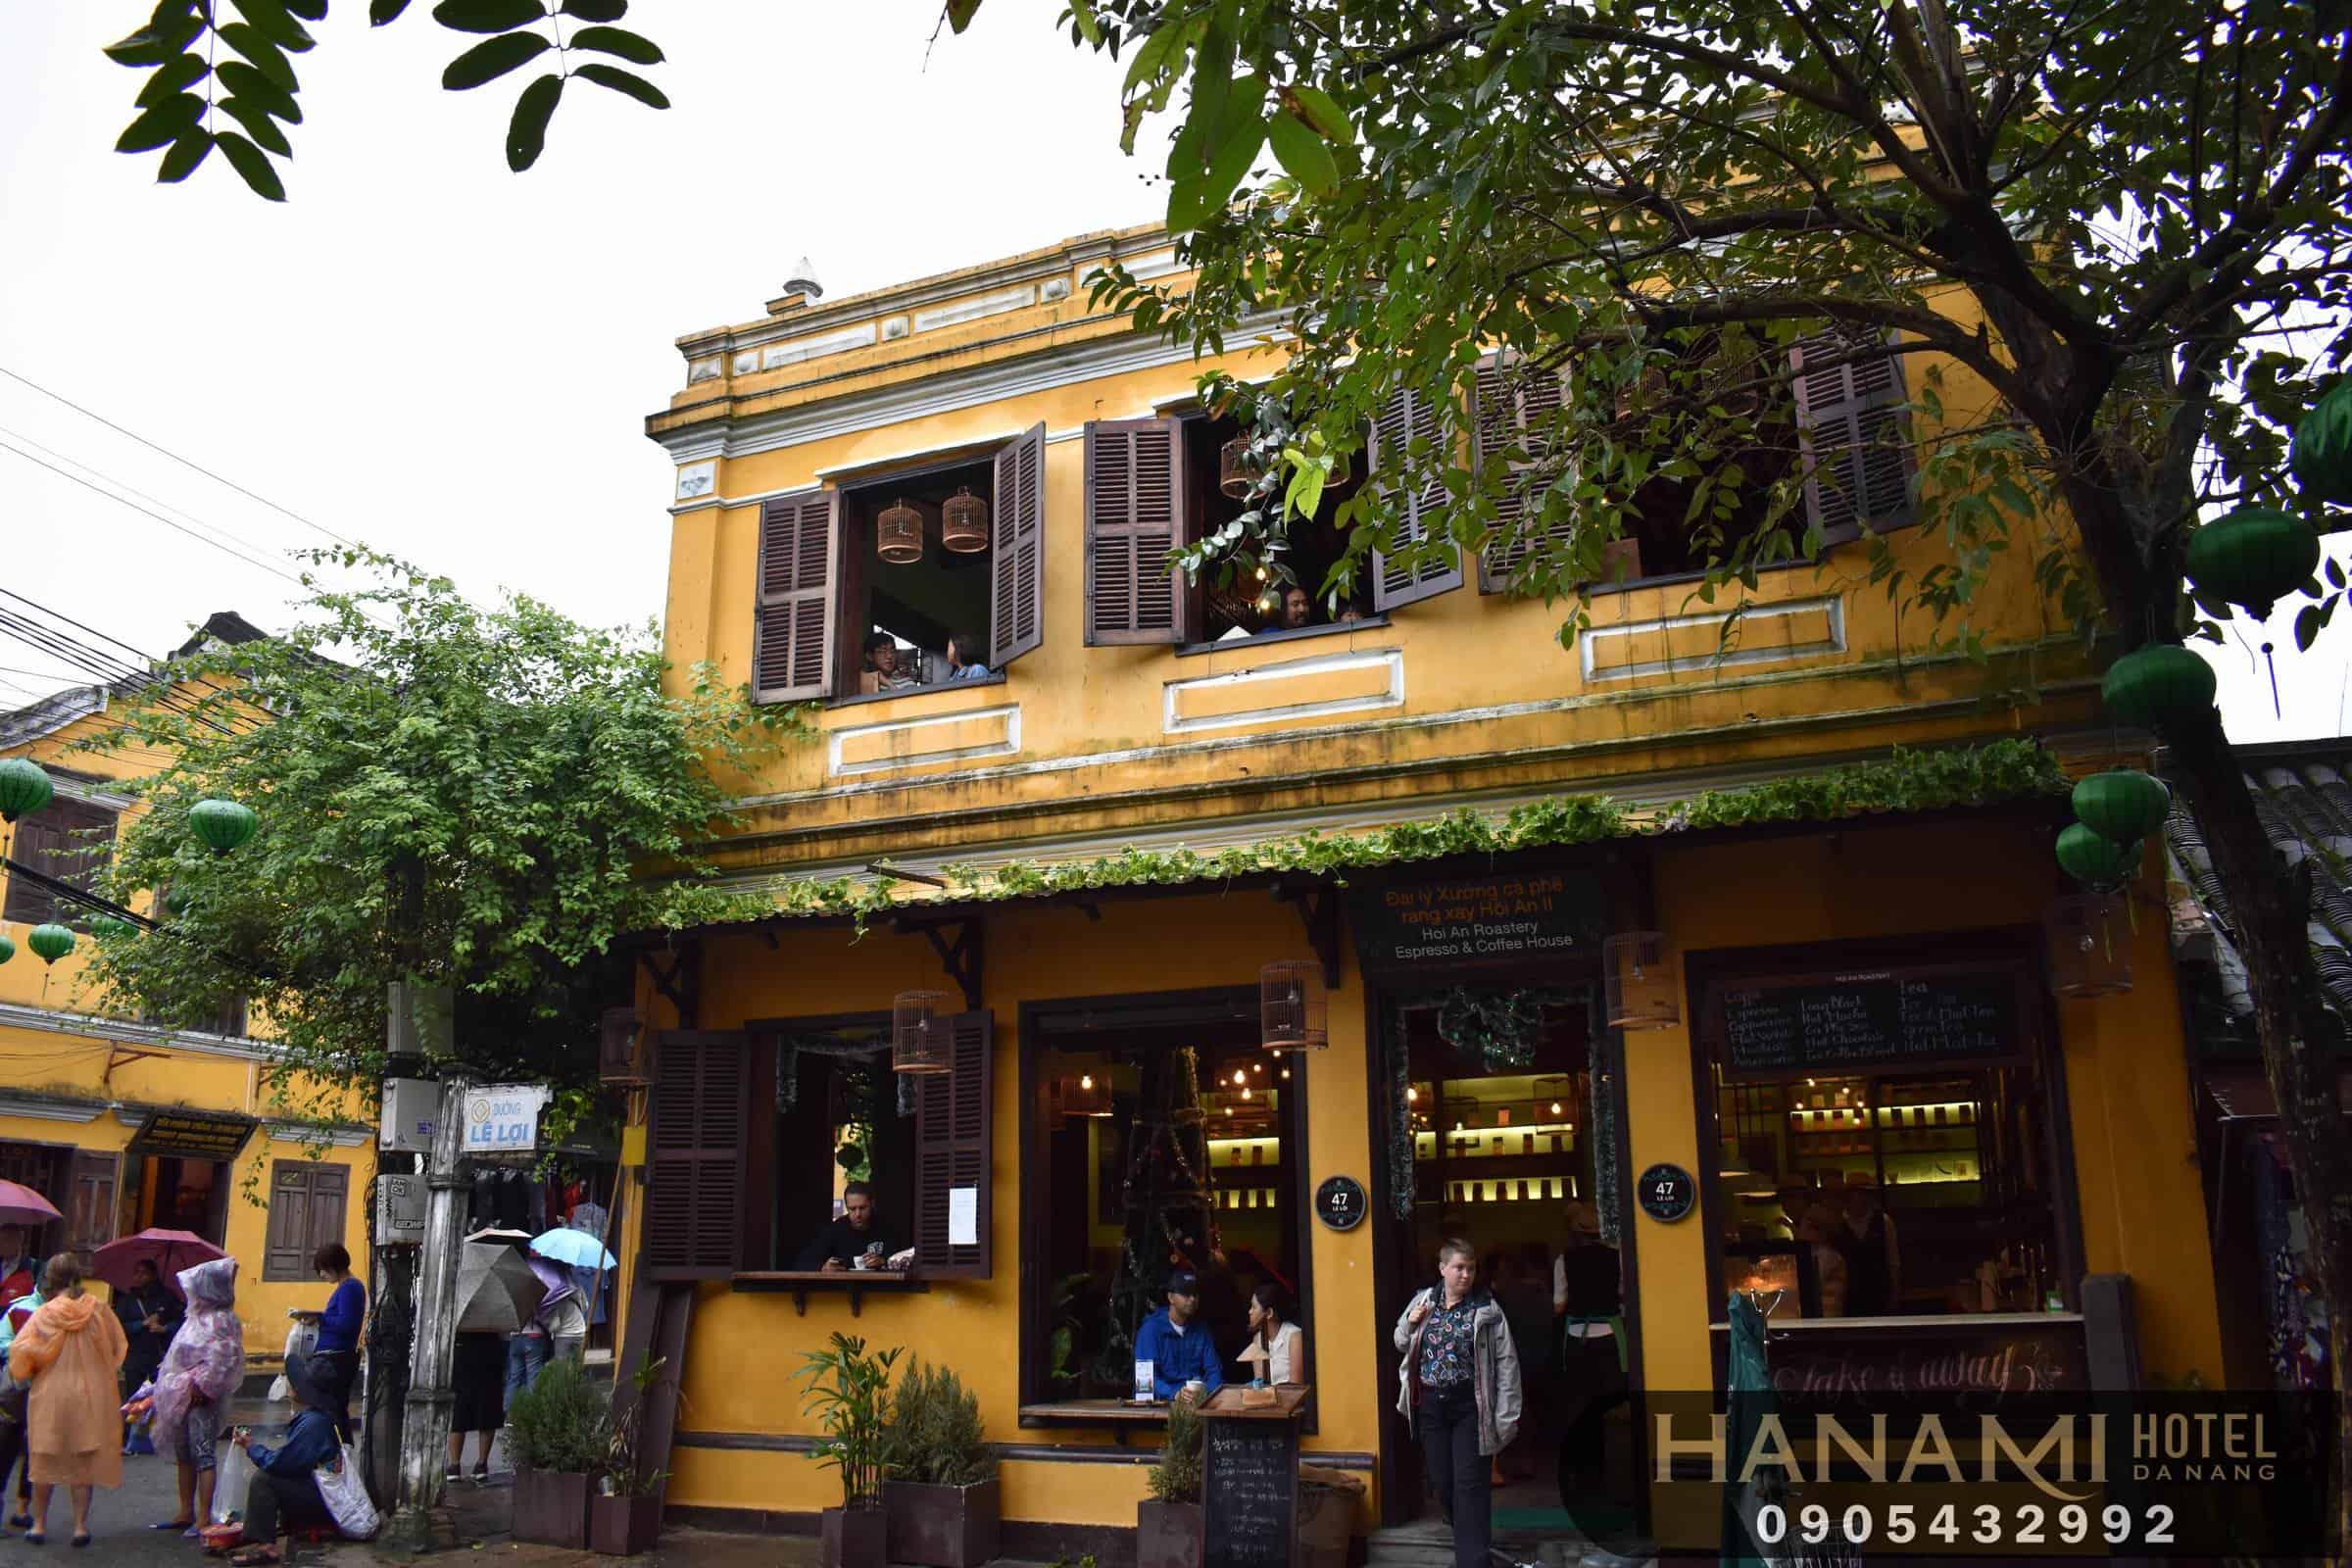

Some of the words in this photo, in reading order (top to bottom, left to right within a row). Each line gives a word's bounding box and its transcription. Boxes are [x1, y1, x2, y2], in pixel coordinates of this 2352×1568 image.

[1514, 898, 1538, 913] An
[1449, 924, 1470, 938] An
[1473, 920, 1539, 937] Roastery
[1396, 942, 1458, 959] Espresso
[1461, 940, 1474, 954] &
[1476, 936, 1523, 953] Coffee
[1526, 934, 1573, 949] House
[470, 1120, 492, 1143] LÊ
[497, 1122, 529, 1146] LỢI
[1655, 1182, 1674, 1195] 47
[1331, 1193, 1348, 1205] 47
